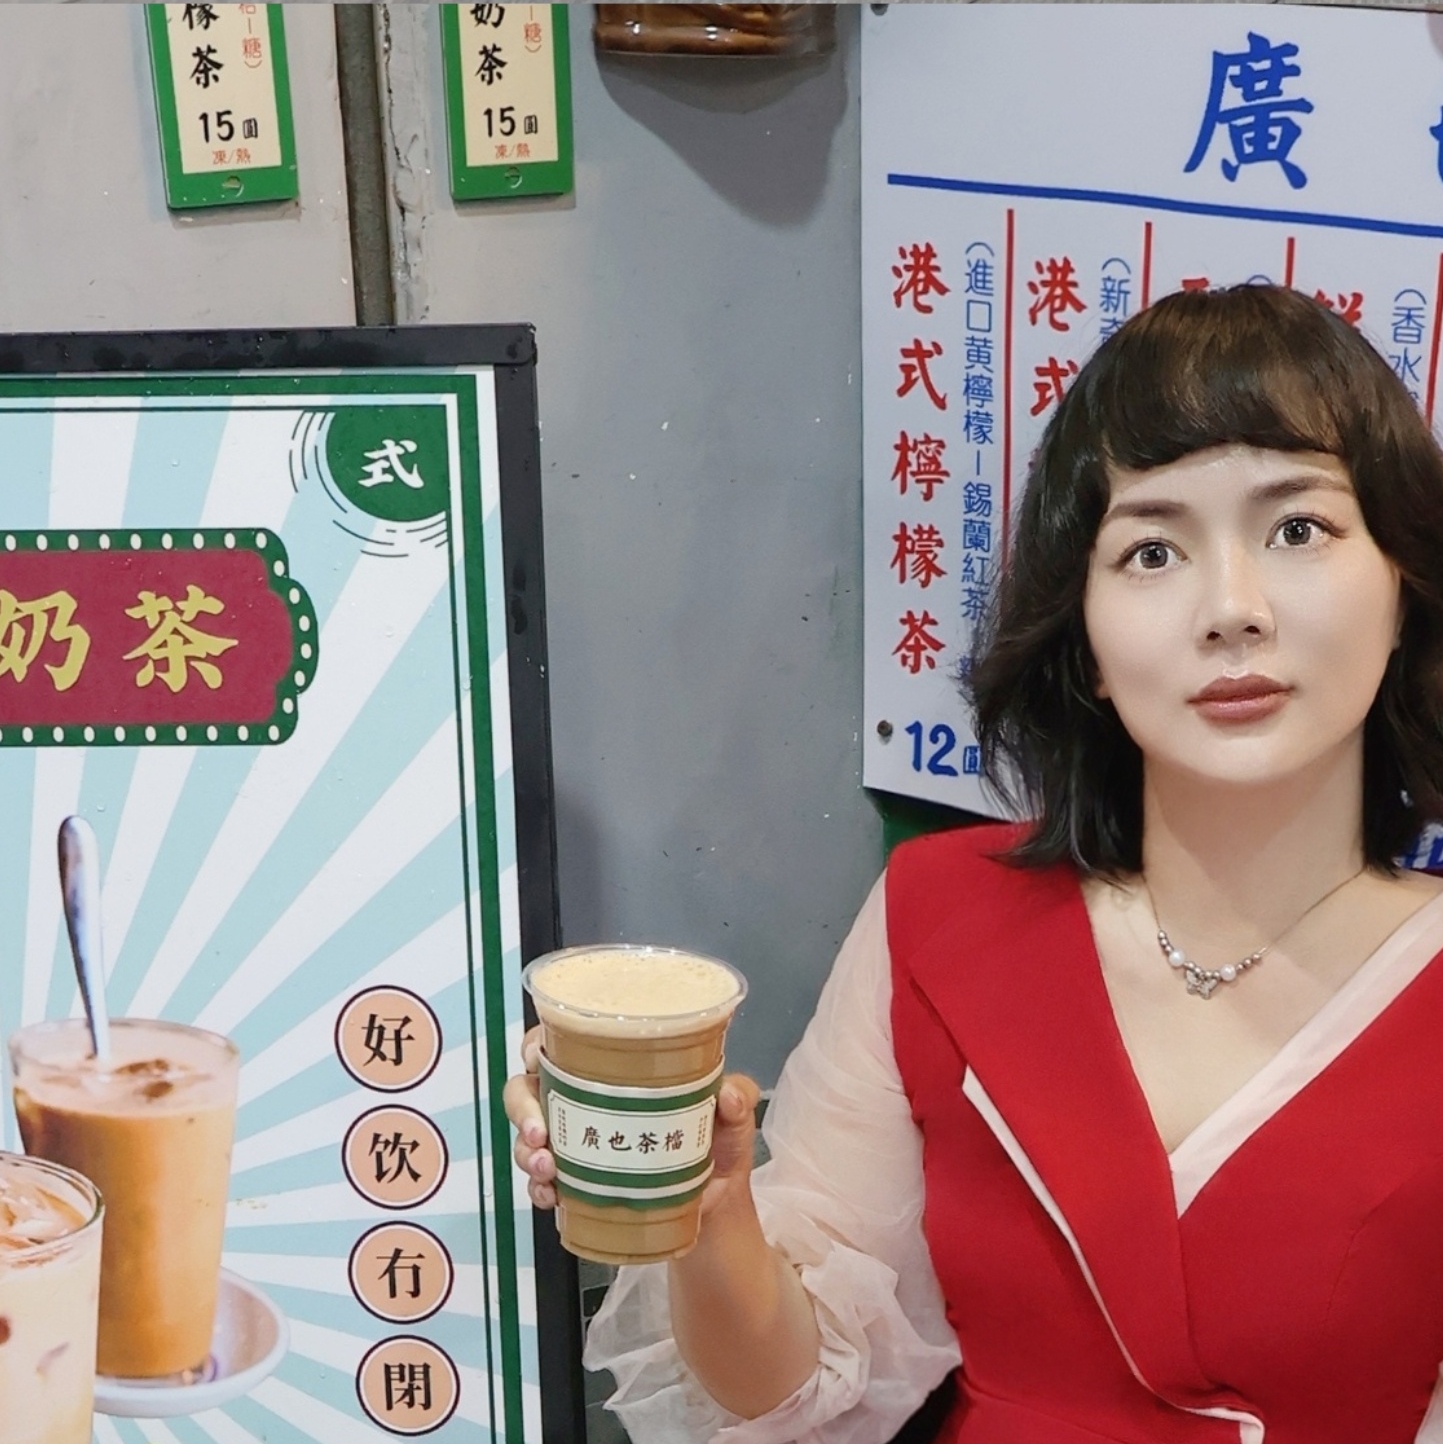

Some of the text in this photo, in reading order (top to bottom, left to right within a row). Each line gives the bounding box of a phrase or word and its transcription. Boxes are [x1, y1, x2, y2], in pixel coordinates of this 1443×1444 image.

[1028, 256, 1087, 416] 港式
[357, 438, 425, 491] 式
[891, 241, 950, 675] 港式檸檬茶
[580, 1125, 685, 1156] 廣也茶檔
